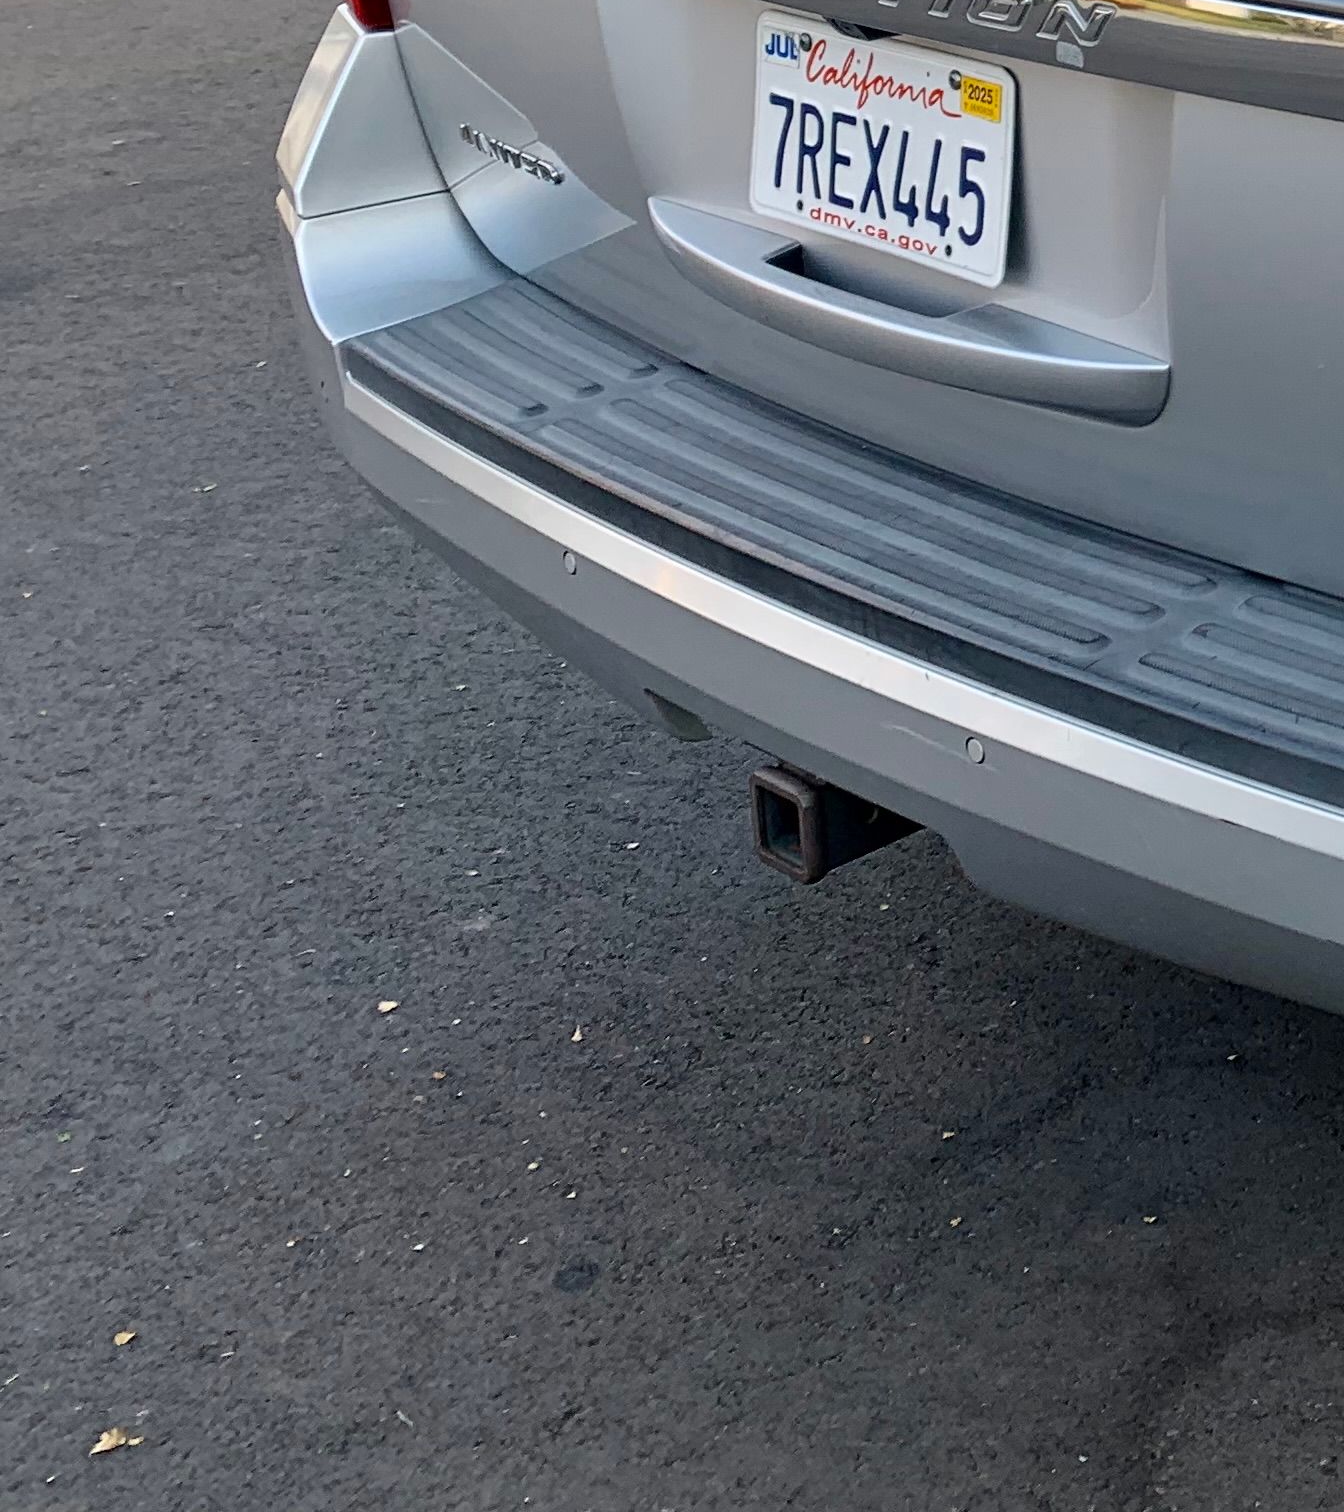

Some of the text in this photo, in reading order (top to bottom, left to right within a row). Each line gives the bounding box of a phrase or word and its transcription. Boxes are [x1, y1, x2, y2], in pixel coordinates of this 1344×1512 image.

[764, 33, 798, 60] JUL
[805, 39, 963, 119] California
[967, 83, 994, 105] 2025
[768, 91, 987, 247] 7REX445
[809, 206, 939, 257] dmv.ca.gov
